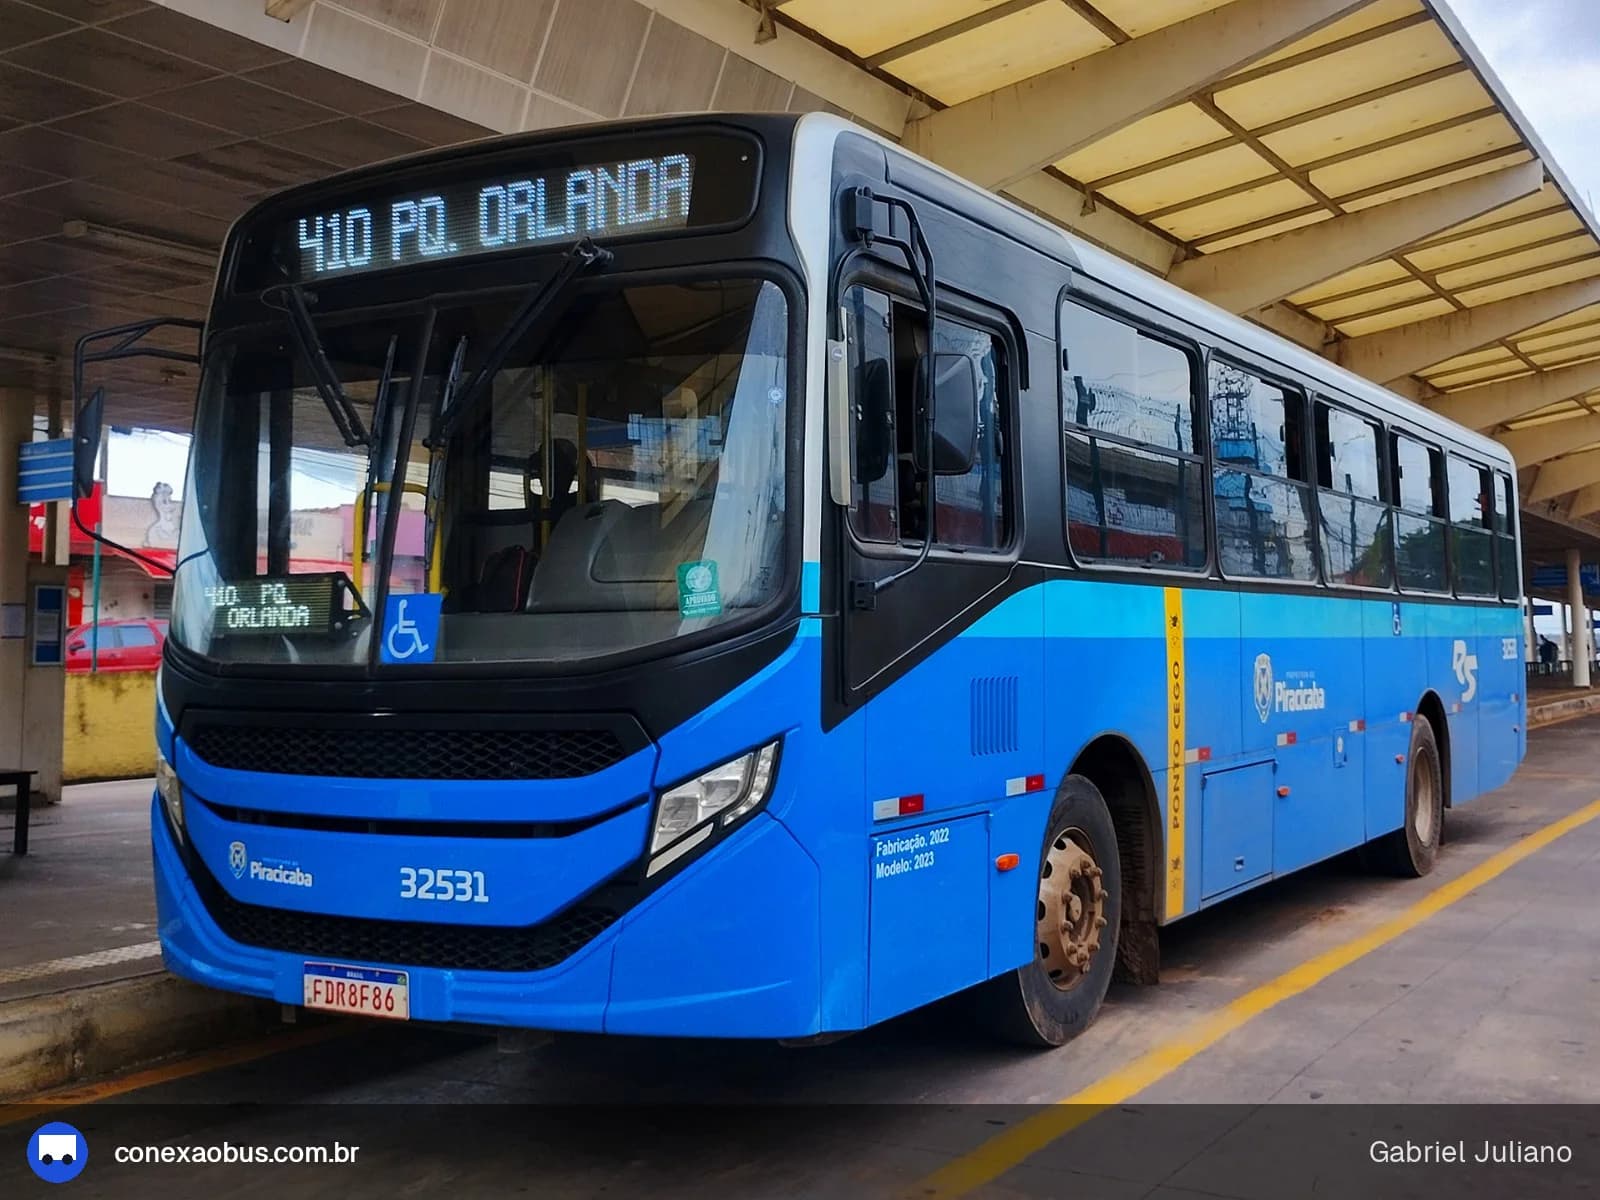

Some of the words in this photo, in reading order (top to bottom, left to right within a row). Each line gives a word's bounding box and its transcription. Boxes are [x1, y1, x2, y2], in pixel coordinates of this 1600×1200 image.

[299, 208, 371, 272] 410
[391, 196, 458, 261] PQ.
[479, 153, 690, 247] ORLANDA
[261, 583, 291, 605] PQ.
[228, 606, 310, 628] ORLANDA
[1172, 661, 1180, 729] CEGO
[1275, 680, 1325, 712] Piracicaba
[1172, 740, 1180, 829] PONTO
[929, 827, 950, 845] 2022
[250, 861, 313, 887] Piracicaba
[876, 859, 912, 879] Modelo:
[914, 851, 935, 869] 2023
[400, 867, 489, 903] 32531
[313, 979, 395, 1012] FDR8F86
